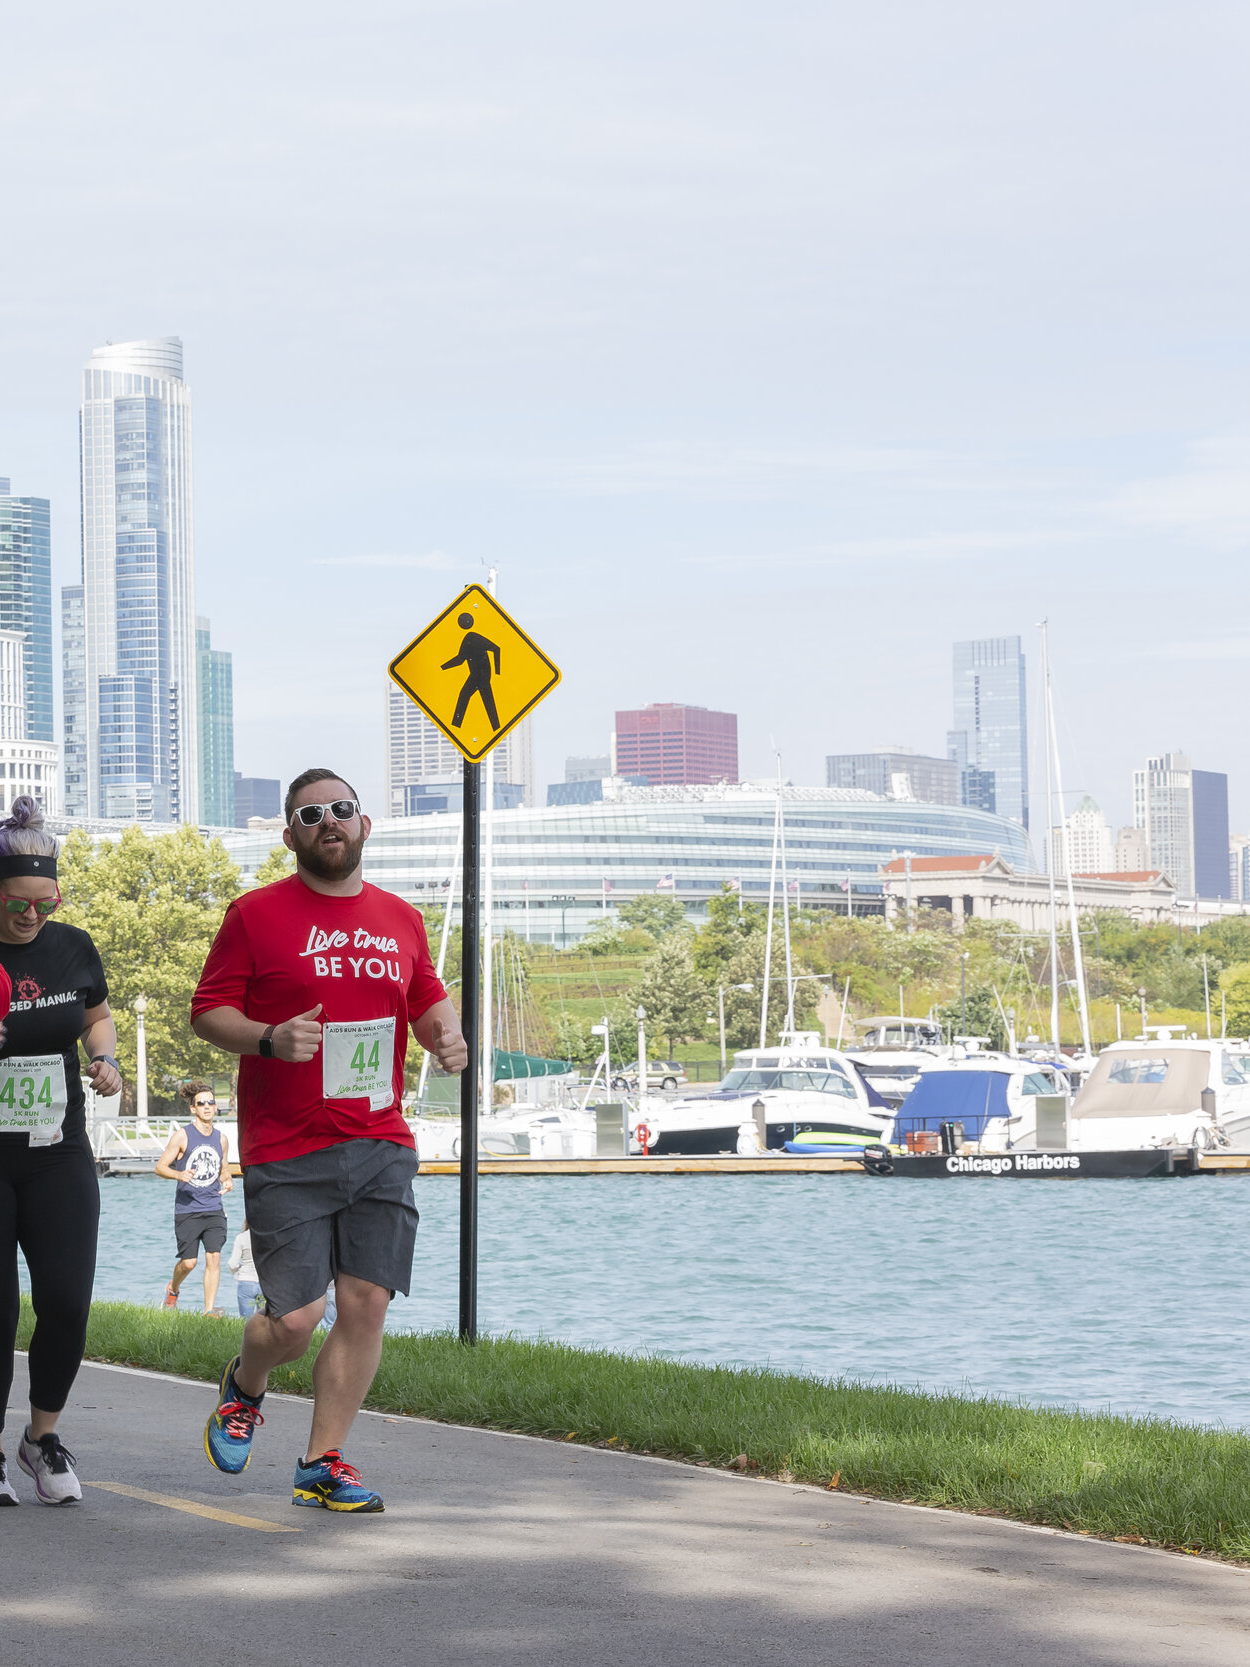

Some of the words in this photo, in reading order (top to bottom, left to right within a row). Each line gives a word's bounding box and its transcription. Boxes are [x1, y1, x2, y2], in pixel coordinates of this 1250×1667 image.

[299, 925, 350, 957] Live
[353, 927, 399, 954] true.
[314, 956, 343, 978] BE
[347, 957, 404, 984] YOU.
[9, 1000, 32, 1012] GED
[36, 990, 77, 1009] MANIAC
[350, 1040, 380, 1074] 44
[367, 1082, 375, 1090] BE
[40, 1117, 58, 1125] YOU.
[946, 1155, 1012, 1174] Chicago
[1015, 1154, 1081, 1170] Harbors
